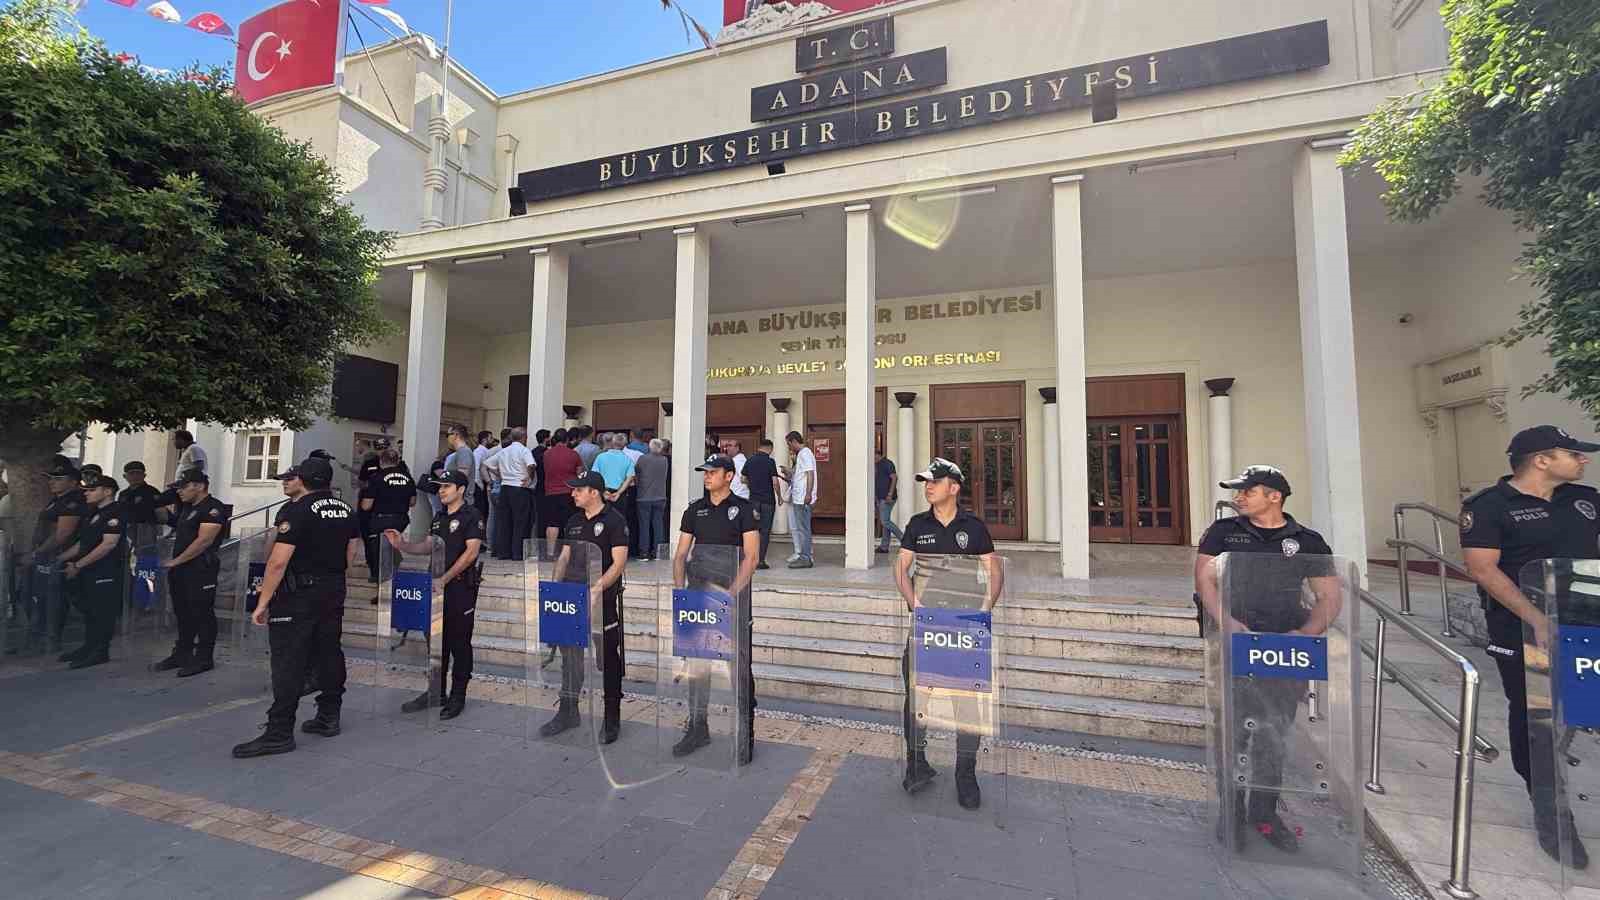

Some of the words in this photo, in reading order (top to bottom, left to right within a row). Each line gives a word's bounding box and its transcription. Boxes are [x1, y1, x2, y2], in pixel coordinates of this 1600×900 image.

[770, 63, 915, 110] ADANA
[598, 121, 837, 182] BÜYÜKŞEHİR
[708, 319, 749, 337] ANA
[904, 289, 1042, 321] BELEDİYESİ
[395, 588, 422, 602] POLİS
[544, 598, 577, 615] POLİS
[678, 608, 718, 625] POLİS
[923, 631, 973, 649] POLİS
[1248, 647, 1310, 668] POLİS
